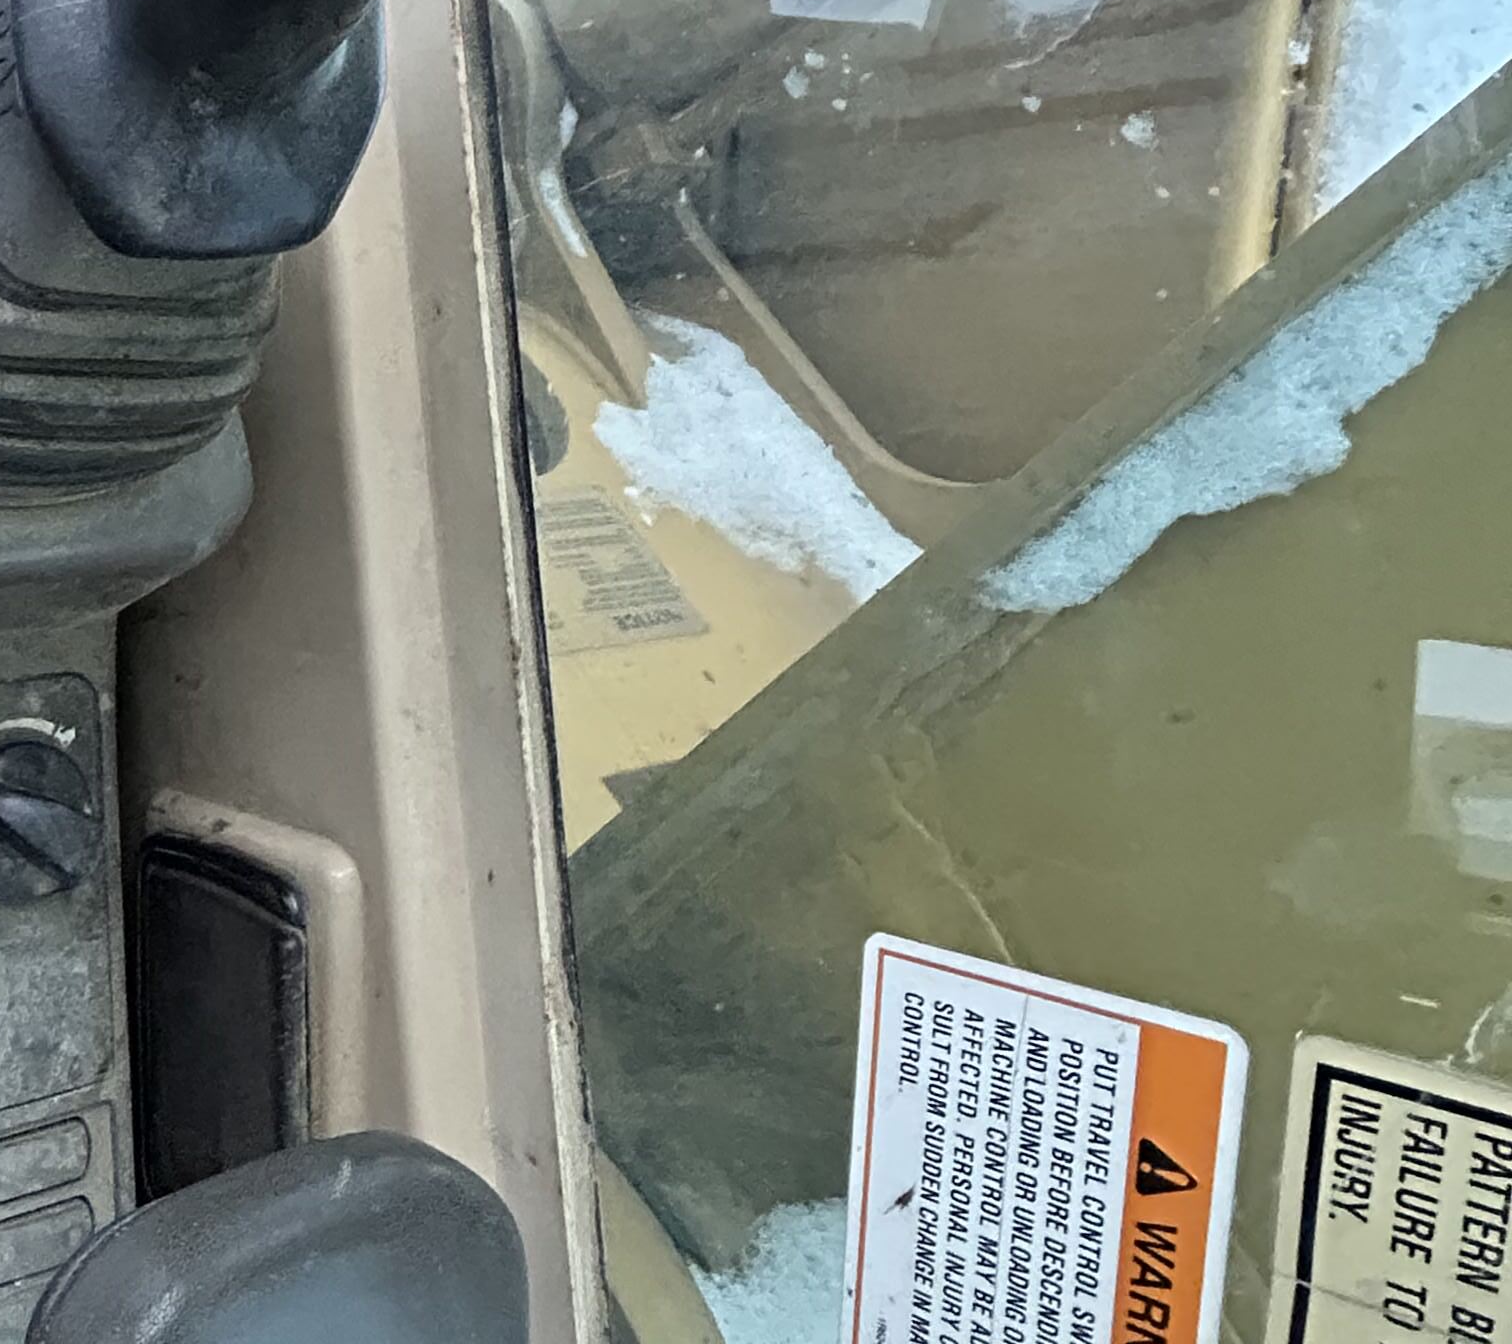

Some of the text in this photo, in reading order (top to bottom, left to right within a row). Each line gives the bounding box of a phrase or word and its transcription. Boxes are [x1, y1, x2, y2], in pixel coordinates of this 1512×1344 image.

[897, 990, 925, 1099] CONTROL.
[930, 1000, 955, 1056] SULT
[956, 1008, 985, 1123] AFFECTED.
[987, 1017, 1017, 1123] MACHINE
[1025, 1026, 1050, 1074] AND
[926, 1056, 950, 1119] FROM
[1052, 1037, 1084, 1144] POSITION
[1092, 1047, 1120, 1098] PUT
[919, 1120, 946, 1205] SUDDEN
[1017, 1075, 1047, 1169] LOADING
[1083, 1102, 1115, 1186] TRAVEL
[1328, 1093, 1383, 1224] INJURY.
[946, 1132, 976, 1244] PERSONAL
[978, 1126, 1009, 1227] CONTROL
[1014, 1171, 1039, 1204] OR
[1045, 1146, 1075, 1235] BEFORE
[1389, 1112, 1449, 1265] FAILURE
[1455, 1131, 1512, 1295] PATTERN
[913, 1206, 939, 1289] CHANGE
[974, 1234, 1000, 1286] MAY
[1004, 1205, 1036, 1325] UNLOADING
[1073, 1194, 1107, 1298] CONTROL
[911, 1288, 933, 1314] IN
[940, 1250, 966, 1333] INJURY
[971, 1287, 996, 1320] BE
[1382, 1280, 1428, 1332] TO
